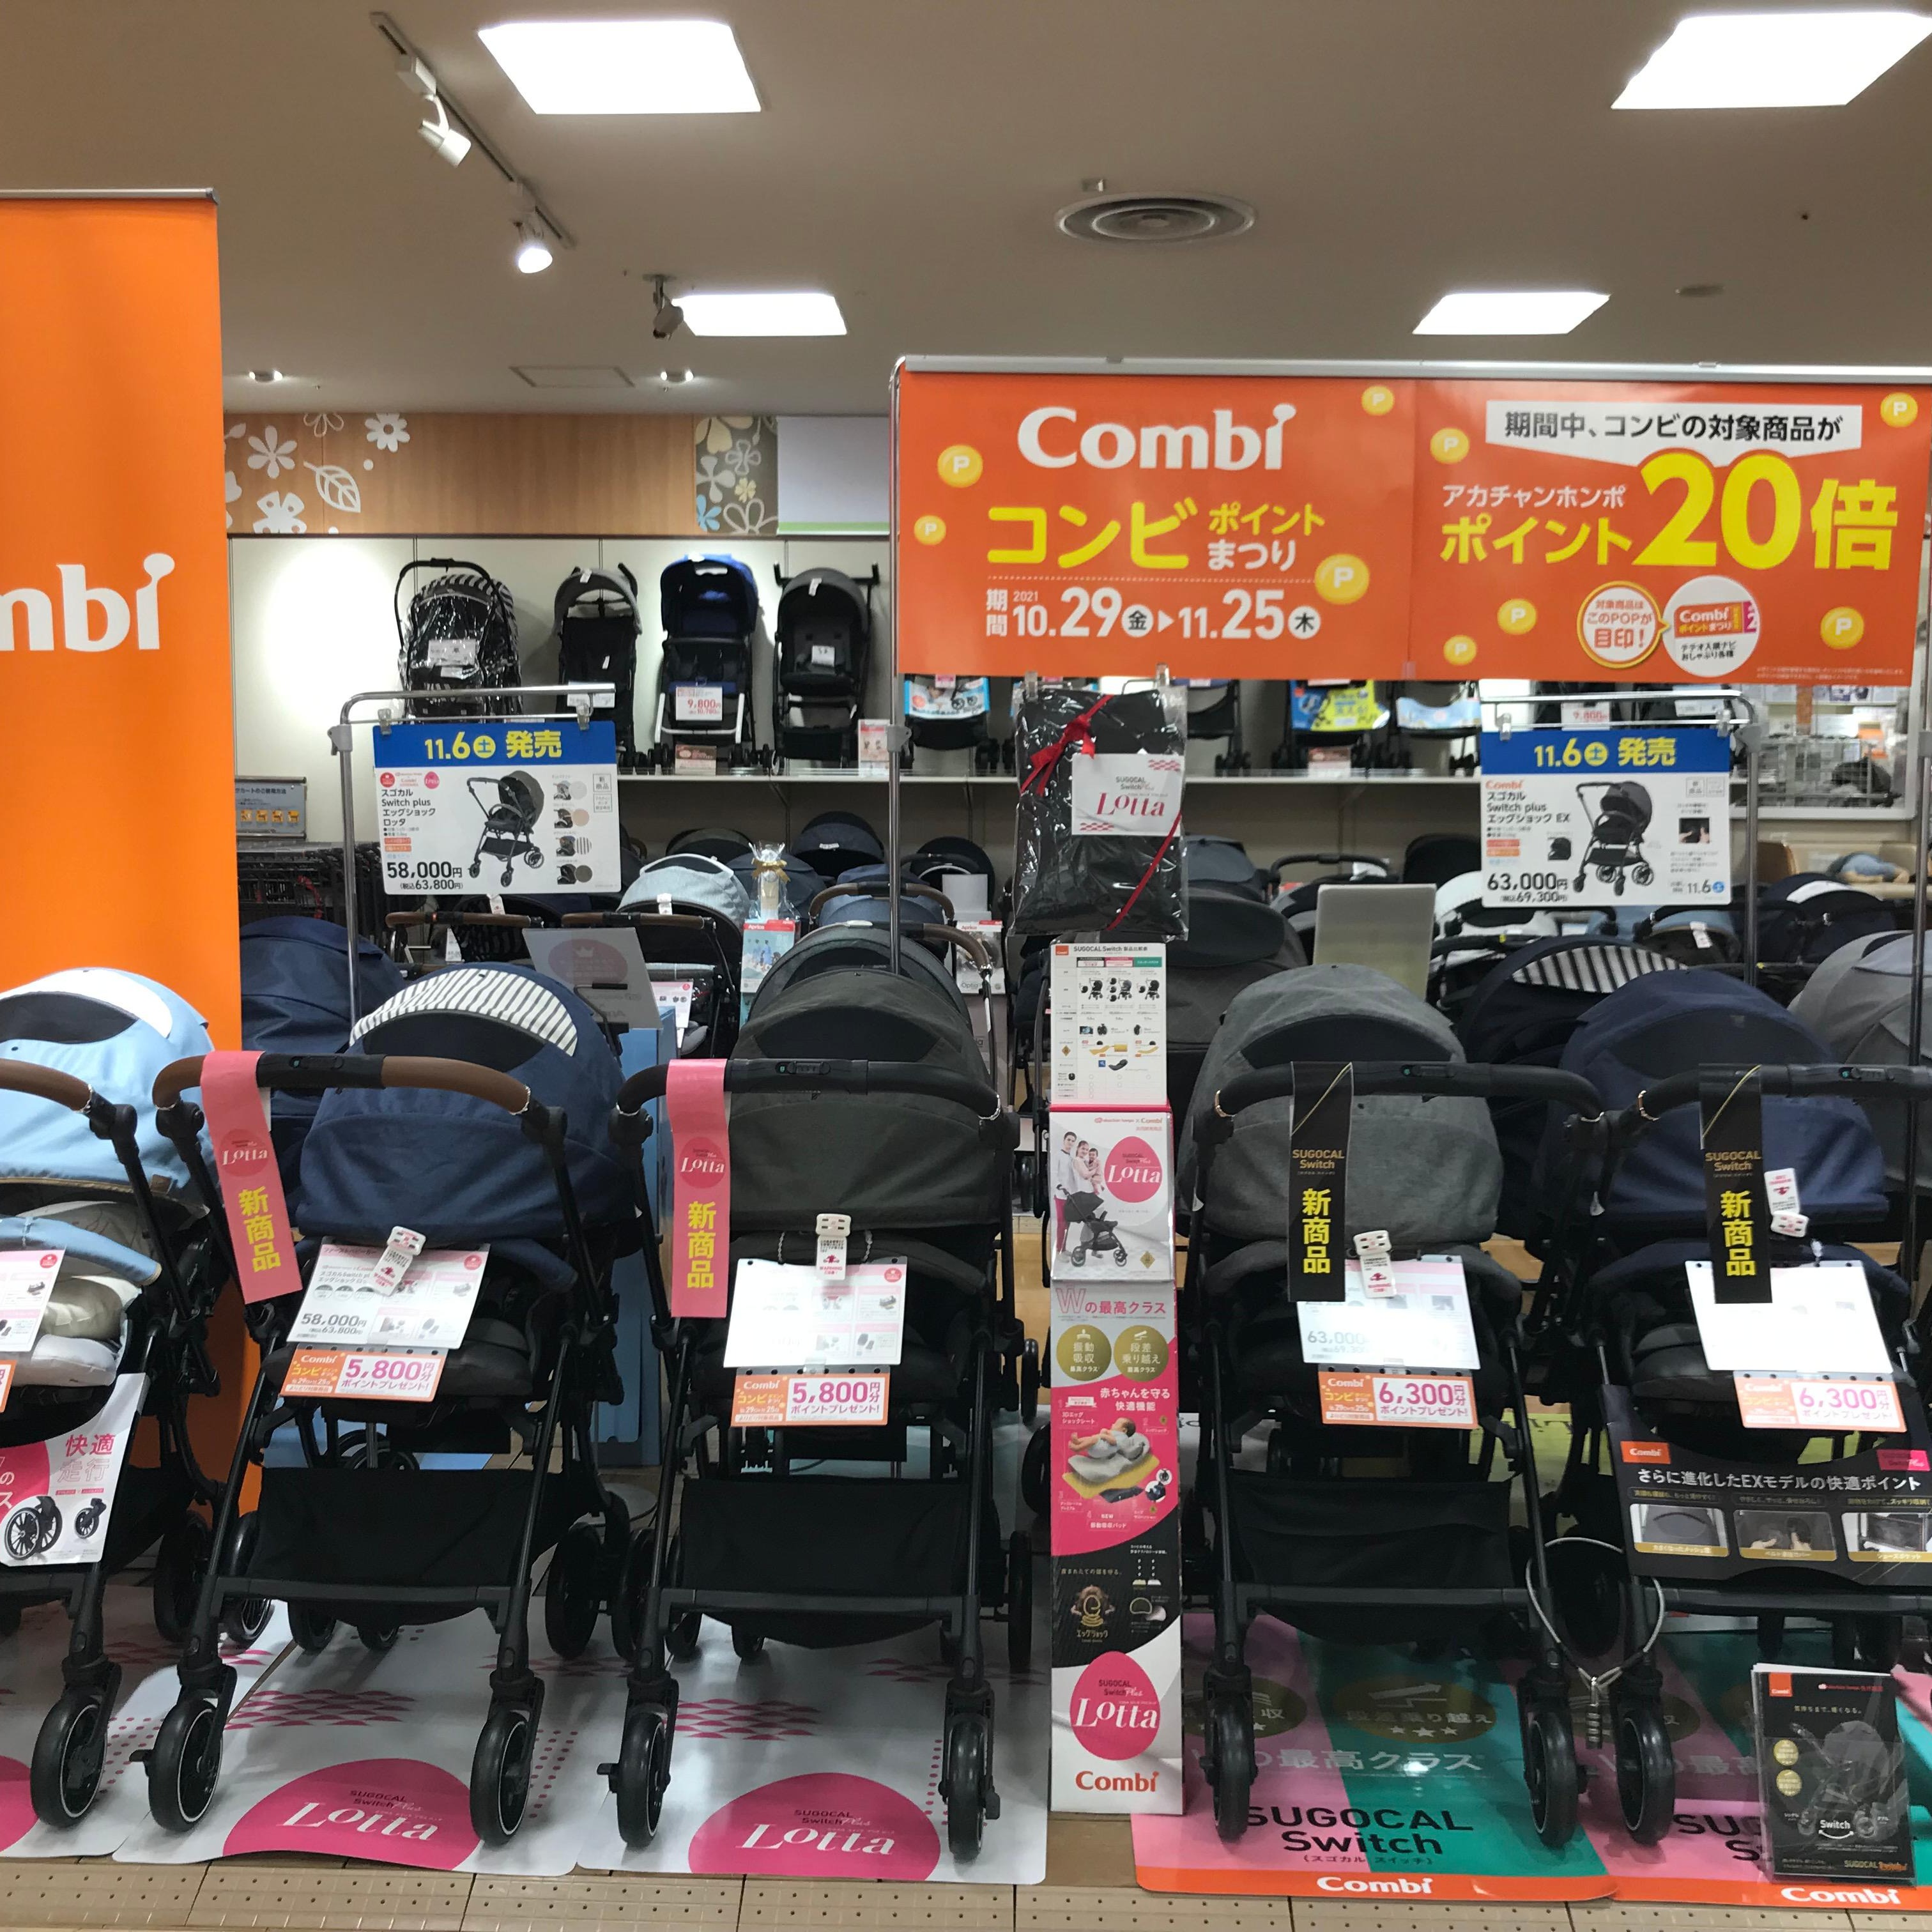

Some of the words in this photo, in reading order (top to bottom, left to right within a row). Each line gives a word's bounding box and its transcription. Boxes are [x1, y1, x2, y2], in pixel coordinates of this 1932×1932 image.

[1505, 411, 1844, 443] 期間中、コンビの対象商品が
[1017, 402, 1298, 471] Combi
[1442, 485, 1627, 509] アカチャンホンポ
[1208, 502, 1325, 535] ポイント
[988, 497, 1199, 570] コンビ
[1207, 540, 1298, 571] まつり
[1013, 590, 1039, 603] 2021
[1595, 599, 1644, 610] 対象商品は
[1587, 612, 1652, 625] このPOPが
[1679, 608, 1729, 624] Combi
[505, 729, 563, 759] 発売
[1617, 737, 1676, 767] 発売
[1485, 779, 1524, 790] Combi
[381, 799, 410, 807] Switch
[413, 798, 431, 808] plus
[1487, 792, 1526, 801] スゴカル
[1096, 792, 1165, 817] Lotta
[1487, 802, 1521, 813] Switch
[1524, 803, 1547, 815] plus
[383, 808, 436, 816] エッグショック
[1487, 813, 1552, 824] エッグショック
[1555, 813, 1571, 822] EX
[386, 861, 463, 880] 58,000円
[1487, 872, 1568, 891] 63,000円
[222, 1148, 268, 1167] Lotta
[1292, 1149, 1346, 1159] SUGOCAL
[1705, 1150, 1762, 1162] SUGOCAL
[680, 1156, 726, 1174] Lotta
[1300, 1159, 1335, 1169] Switch
[1713, 1162, 1753, 1172] Switch
[1107, 1164, 1161, 1183] Lotta
[238, 1186, 281, 1273] 新商品
[1302, 1188, 1331, 1274] 新商品
[1720, 1190, 1756, 1276] 新商品
[686, 1200, 717, 1289] 新商品
[1073, 1342, 1094, 1353] 振動
[1130, 1342, 1152, 1353] 段差
[300, 1354, 338, 1364] Combi
[1073, 1353, 1094, 1364] 吸収
[1121, 1353, 1161, 1365] 乗り越え
[743, 1379, 780, 1390] Combi
[1328, 1377, 1365, 1388] Combi
[1100, 1388, 1171, 1399] 赤ちゃんを守る
[1115, 1401, 1156, 1411] 快適機能
[65, 1433, 116, 1457] 快適
[1629, 1447, 1662, 1457] Combi
[57, 1459, 111, 1483] 走行
[1637, 1468, 1922, 1492] さらに進化したEXモデルの快適ポイント
[1098, 1679, 1132, 1687] SUGOCAL
[1103, 1688, 1126, 1696] Switch
[1072, 1698, 1158, 1729] Lotta
[1075, 1770, 1160, 1793] Combi
[350, 1790, 407, 1802] SUGOCAL
[353, 1798, 394, 1809] Switch
[793, 1809, 854, 1818] SUGOCAL
[1246, 1806, 1475, 1832] SUGOCAL
[275, 1802, 439, 1841] Lotta
[1820, 1820, 1851, 1829] Switch
[735, 1823, 895, 1855] Lotta
[1281, 1831, 1443, 1855] Switch
[1844, 1860, 1878, 1869] SUGOCAL
[1316, 1876, 1434, 1894] Combi
[1780, 1887, 1902, 1905] Combi
